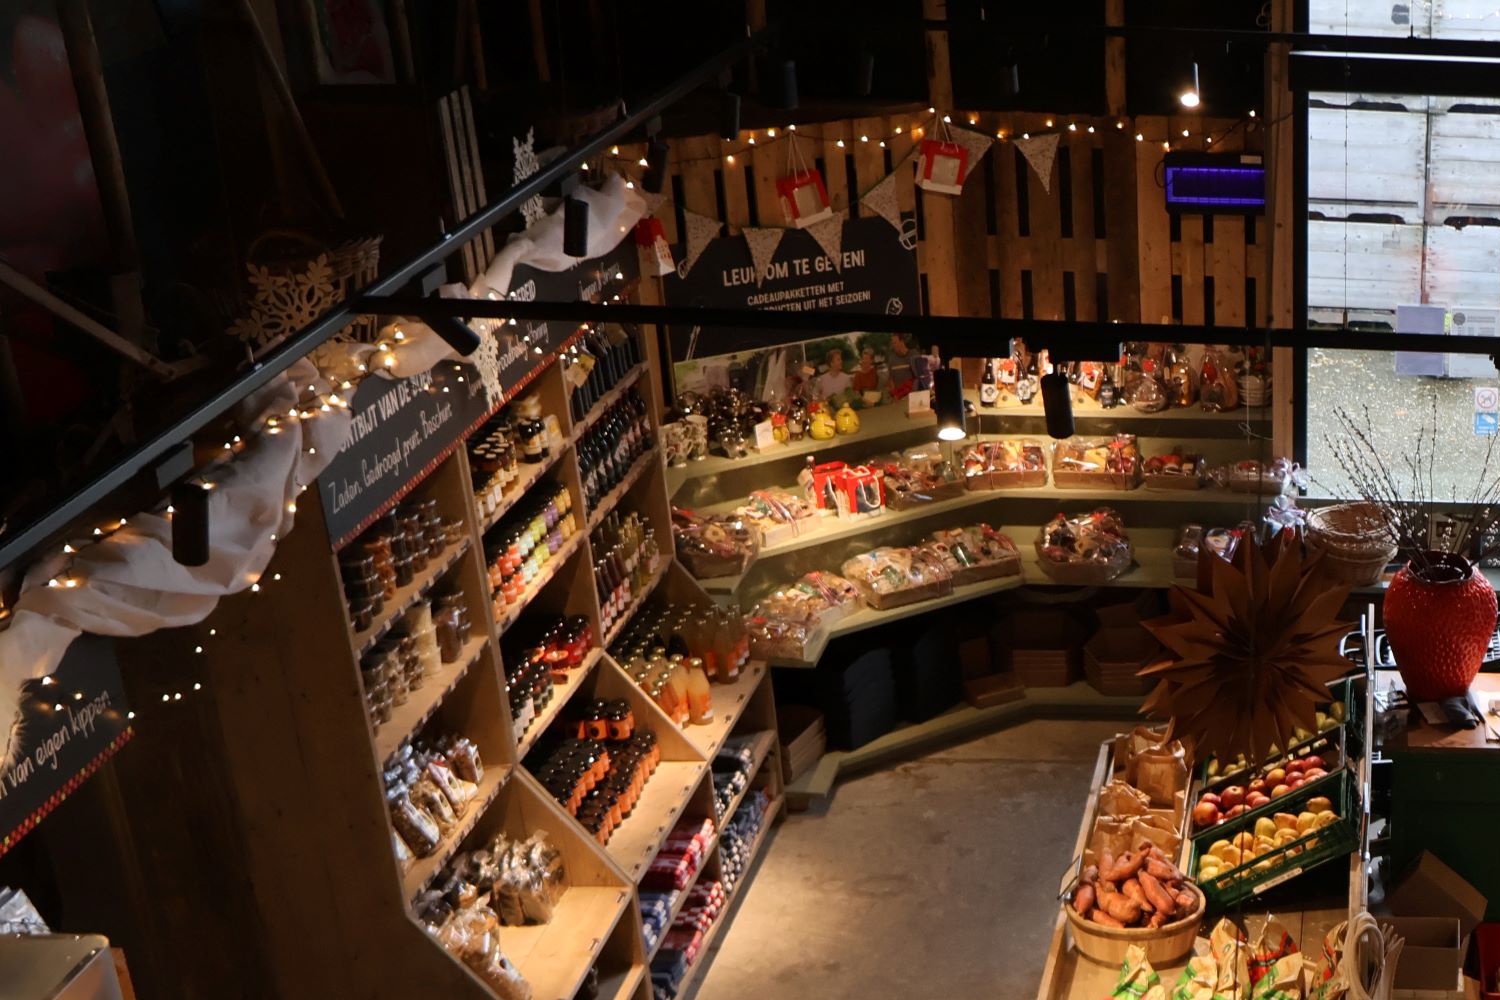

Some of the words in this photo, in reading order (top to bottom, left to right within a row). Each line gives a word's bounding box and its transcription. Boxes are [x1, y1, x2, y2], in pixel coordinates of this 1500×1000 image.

[766, 260, 788, 280] OM
[793, 257, 810, 275] TE
[815, 249, 865, 273] GEEN!
[747, 286, 826, 306] CADEAUPAKKETTEN
[828, 281, 844, 293] MET
[803, 299, 816, 312] UIT
[818, 296, 833, 308] HET
[377, 386, 401, 421] VAN
[397, 379, 412, 409] DE
[8, 756, 35, 788] van
[35, 724, 71, 771] eigen
